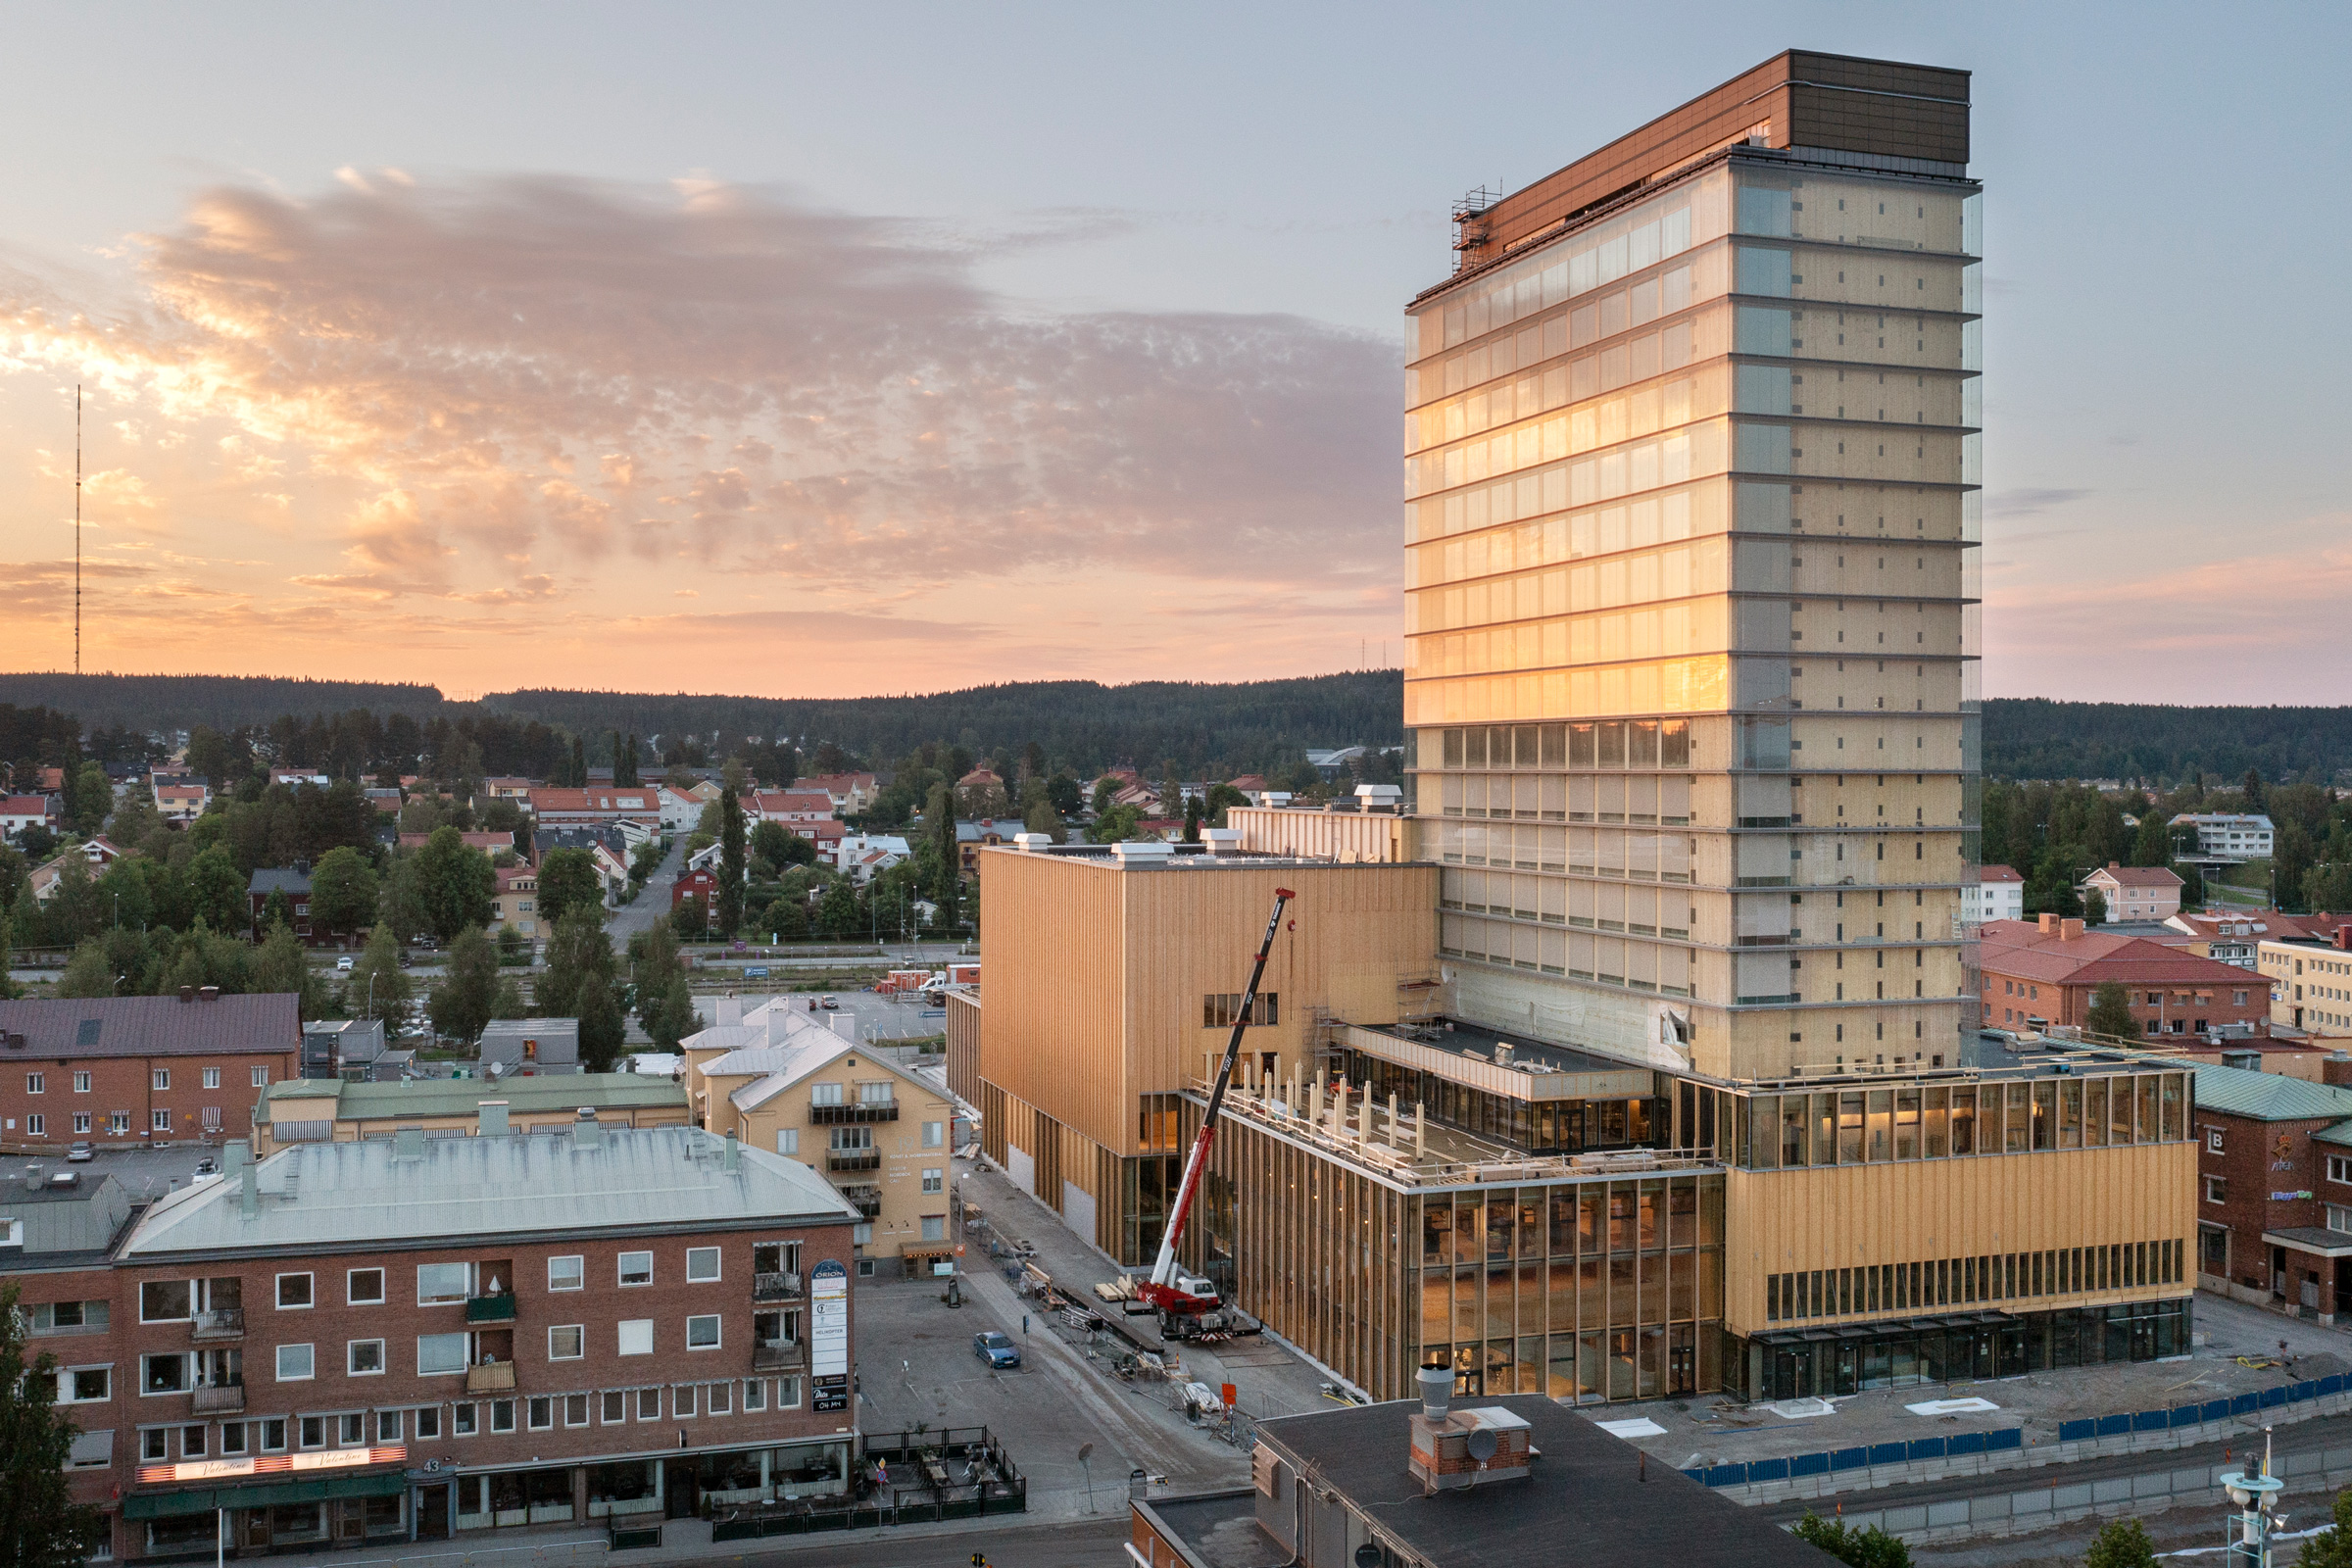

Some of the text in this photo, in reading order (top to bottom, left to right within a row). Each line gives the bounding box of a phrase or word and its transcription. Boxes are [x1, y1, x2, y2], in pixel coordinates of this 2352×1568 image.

[898, 1136, 914, 1152] 19
[2213, 1134, 2223, 1147] B
[319, 1452, 362, 1466] Valentine
[423, 1460, 440, 1472] 43
[202, 1462, 247, 1476] Valentine
